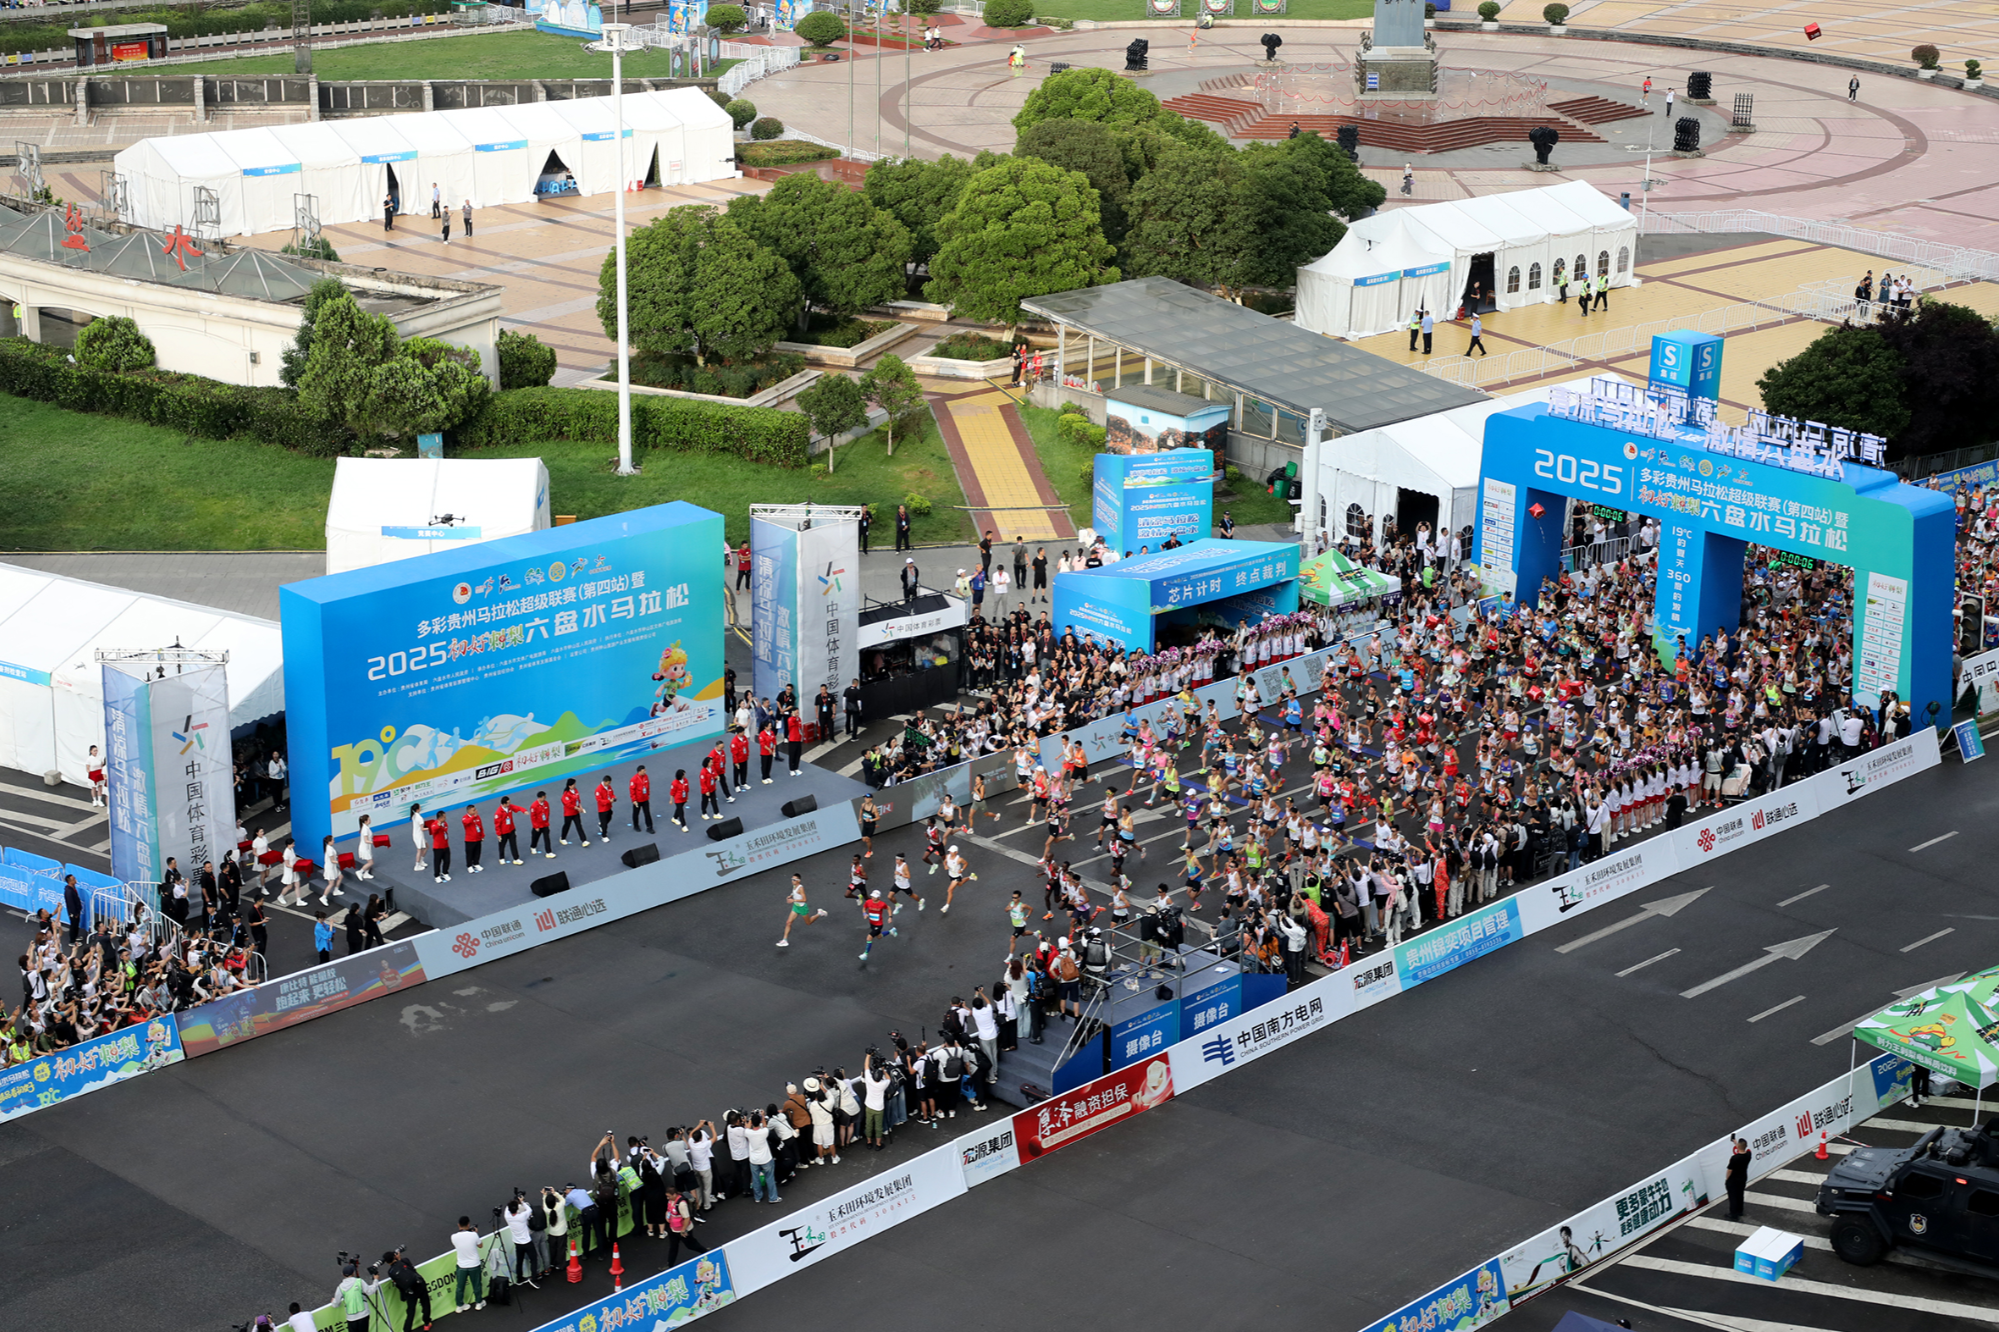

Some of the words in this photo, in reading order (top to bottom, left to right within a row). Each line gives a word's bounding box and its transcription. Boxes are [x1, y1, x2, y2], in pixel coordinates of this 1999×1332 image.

[1664, 345, 1677, 366] S
[1702, 347, 1712, 367] S
[1547, 386, 1677, 441] 清凉马拉松
[1703, 420, 1845, 479] 激情六盘水
[1534, 448, 1623, 495] 2025
[1593, 505, 1623, 522] 0:00:06
[1235, 561, 1287, 587] 终点裁判
[1780, 551, 1814, 569] 0:00:06
[1168, 577, 1222, 603] 芯片计时
[417, 571, 645, 640] 多彩贵州马拉松超级联赛（第四站）暨
[897, 617, 942, 633] 中国体育彩票
[477, 764, 501, 779] BIG
[1716, 818, 1743, 836] 中国联通
[1766, 802, 1798, 826] 联通心选
[746, 820, 817, 851] 玉禾田环境发展集团
[556, 898, 607, 925] 联通心选
[480, 919, 523, 940] 中国联通
[485, 938, 503, 949] China
[1405, 908, 1510, 971] 贵州锦奕项目管理
[1353, 961, 1393, 990] 宏源集团
[275, 989, 311, 1012] 跑起来
[312, 976, 348, 1000] 更轻松
[1194, 1002, 1229, 1030] 摄像台
[1237, 997, 1323, 1048] 中国南方电网
[1126, 1030, 1163, 1058] 摄像台
[1240, 1046, 1258, 1058] CHINA
[1259, 1032, 1290, 1050] SOUTHERN
[1290, 1021, 1310, 1035] POWER
[1311, 1014, 1325, 1025] GRID
[53, 1033, 141, 1082] 初好刺梨
[1877, 1058, 1898, 1075] 2025
[1813, 1094, 1854, 1129] 联通心选
[963, 1131, 1012, 1165] 宏源集团
[1753, 1125, 1786, 1150] 中国联通
[1755, 1149, 1771, 1161] China
[827, 1174, 912, 1222] 玉禾田环境发展集团
[875, 1194, 916, 1219] 300815
[1620, 1192, 1673, 1237] 更多健康动力
[599, 1275, 689, 1332] 初好刺梨
[1399, 1284, 1472, 1332] 初好刺梨
